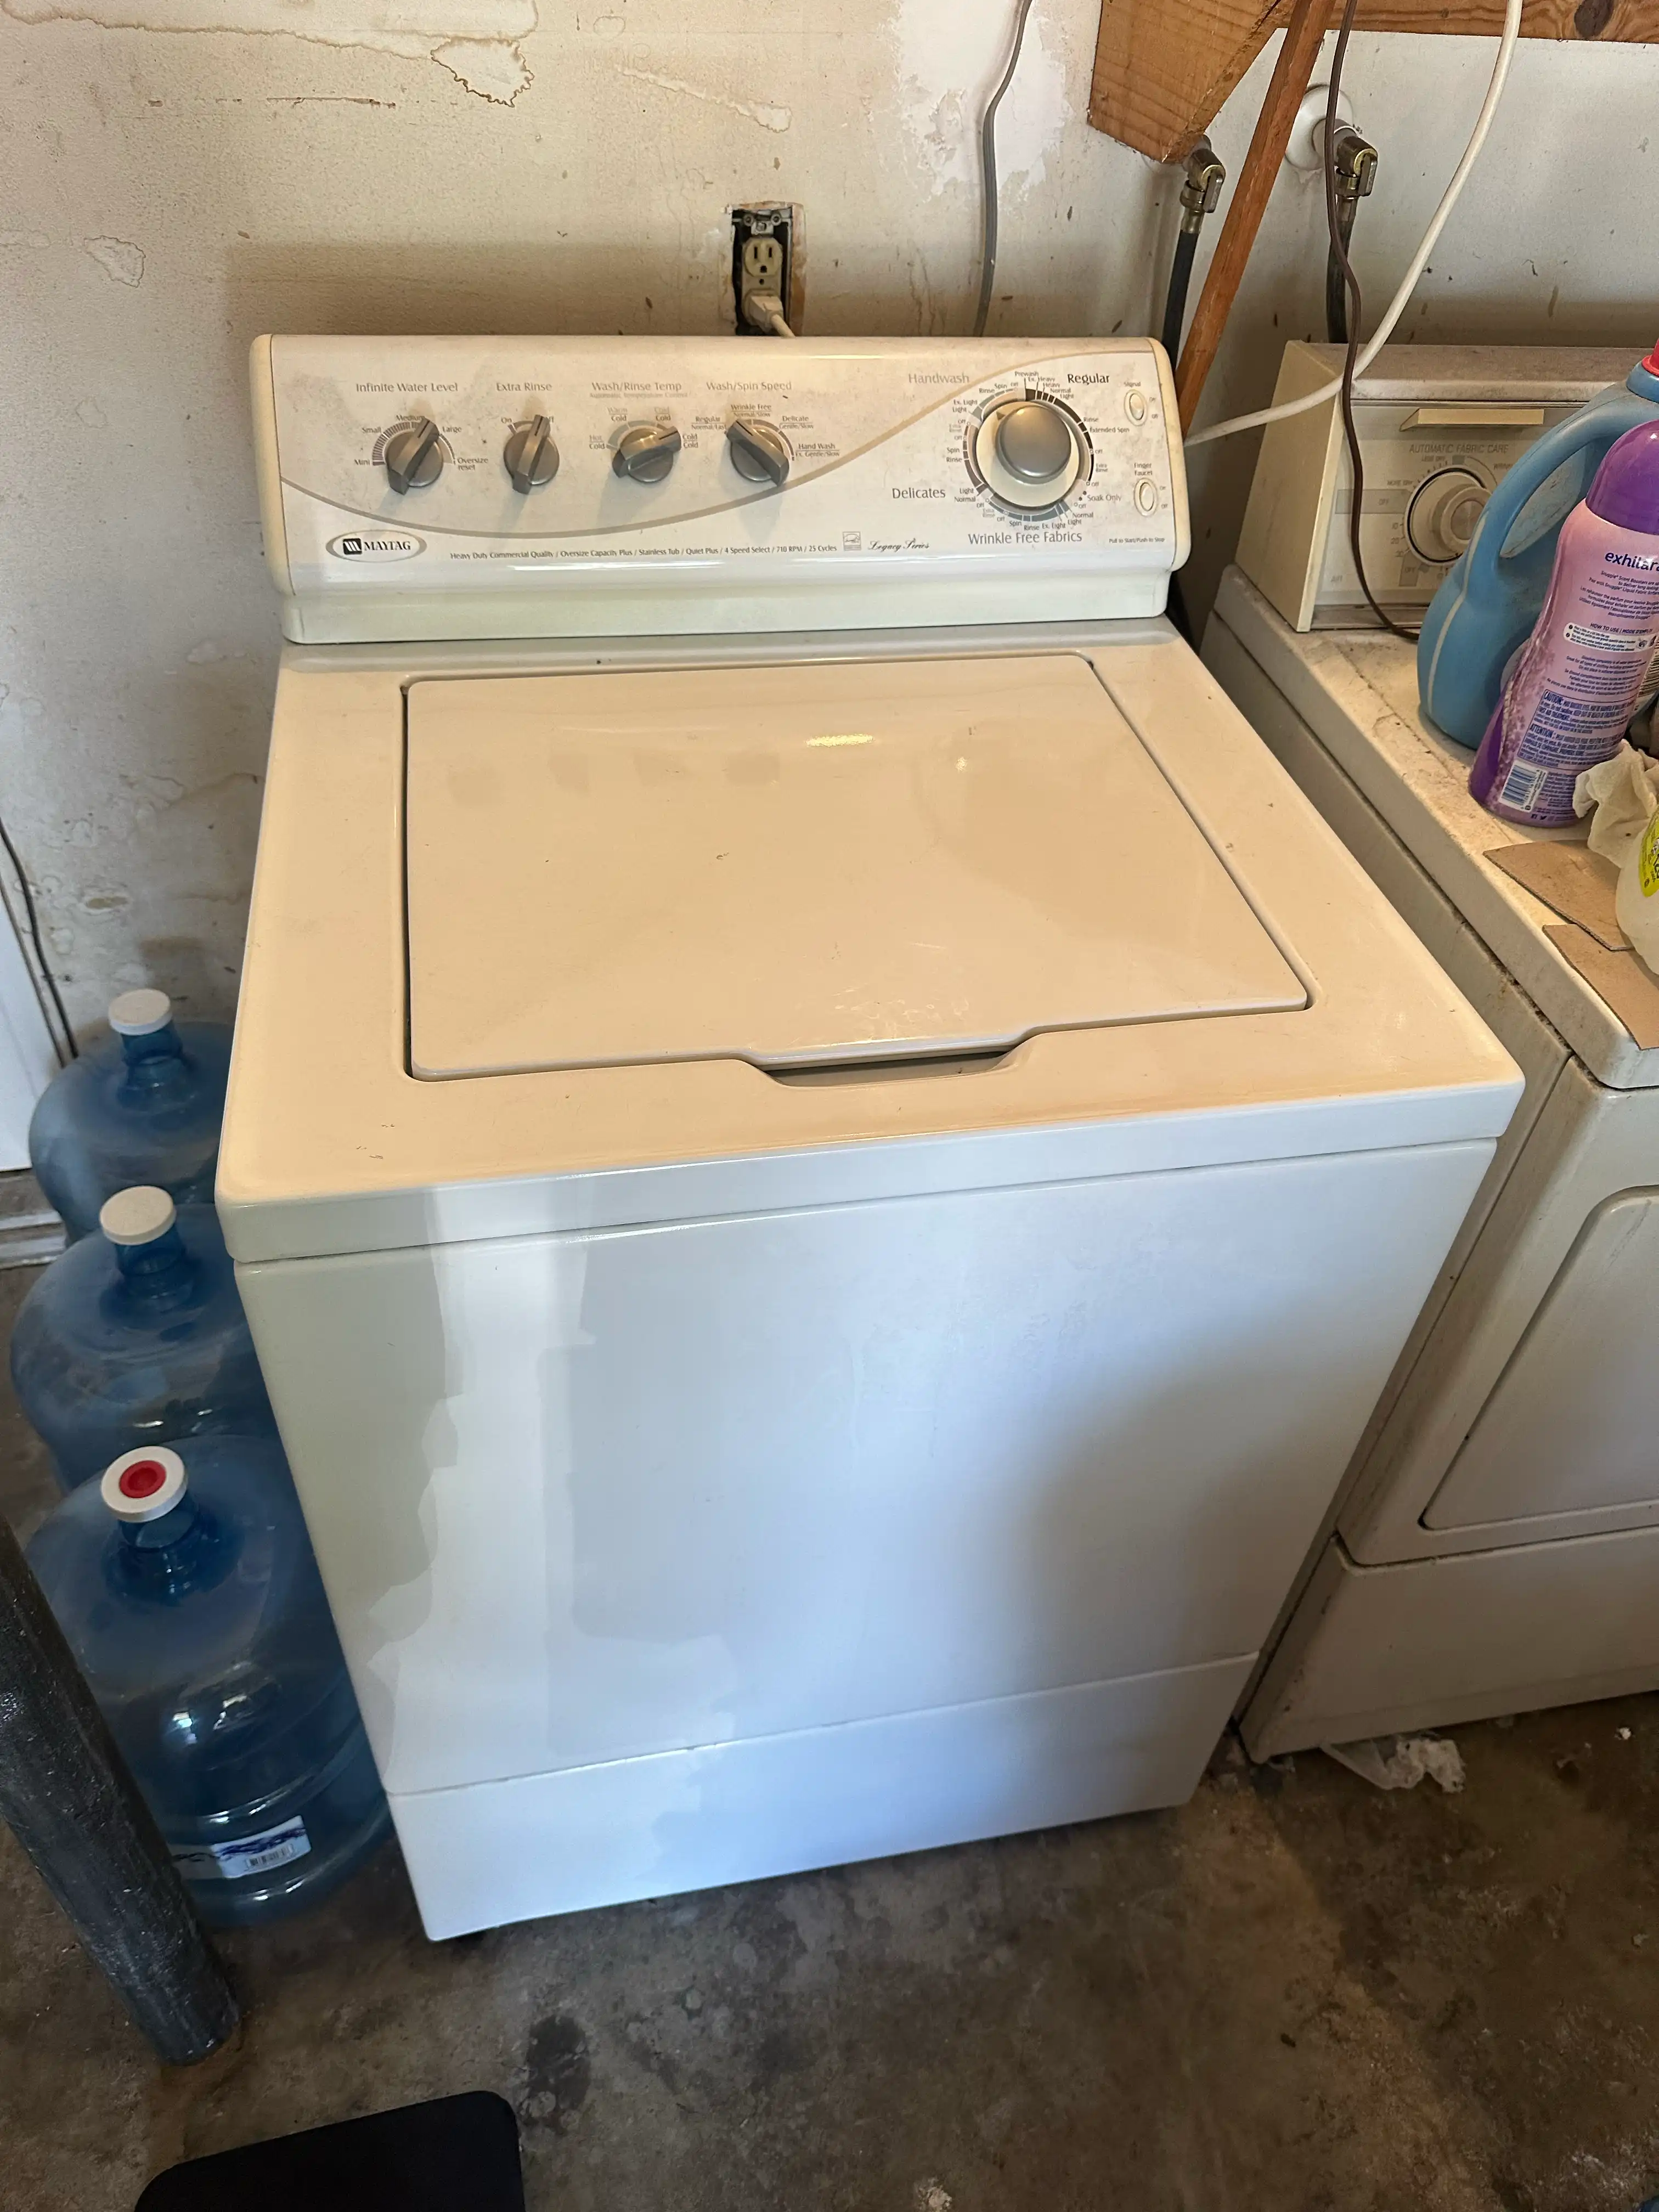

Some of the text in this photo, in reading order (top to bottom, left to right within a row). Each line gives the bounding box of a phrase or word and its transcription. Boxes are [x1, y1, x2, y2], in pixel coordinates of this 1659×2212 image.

[909, 373, 969, 383] Handwash
[1068, 373, 1109, 385] Regular
[356, 382, 458, 392] Infinite Water Level
[496, 382, 552, 392] Extra Rinse
[591, 382, 682, 392] Wash/Rinse Temp
[706, 381, 792, 392] Wash/Spin Speed
[1409, 443, 1509, 454] AUTOMATIC FABRIC CARE
[892, 487, 946, 499] Delicates
[1105, 494, 1122, 502] Only
[968, 532, 1082, 545] Wrinkle Free Fabrics
[364, 541, 411, 551] MAYTAG
[868, 540, 901, 552] Legacy
[904, 538, 929, 550] Series
